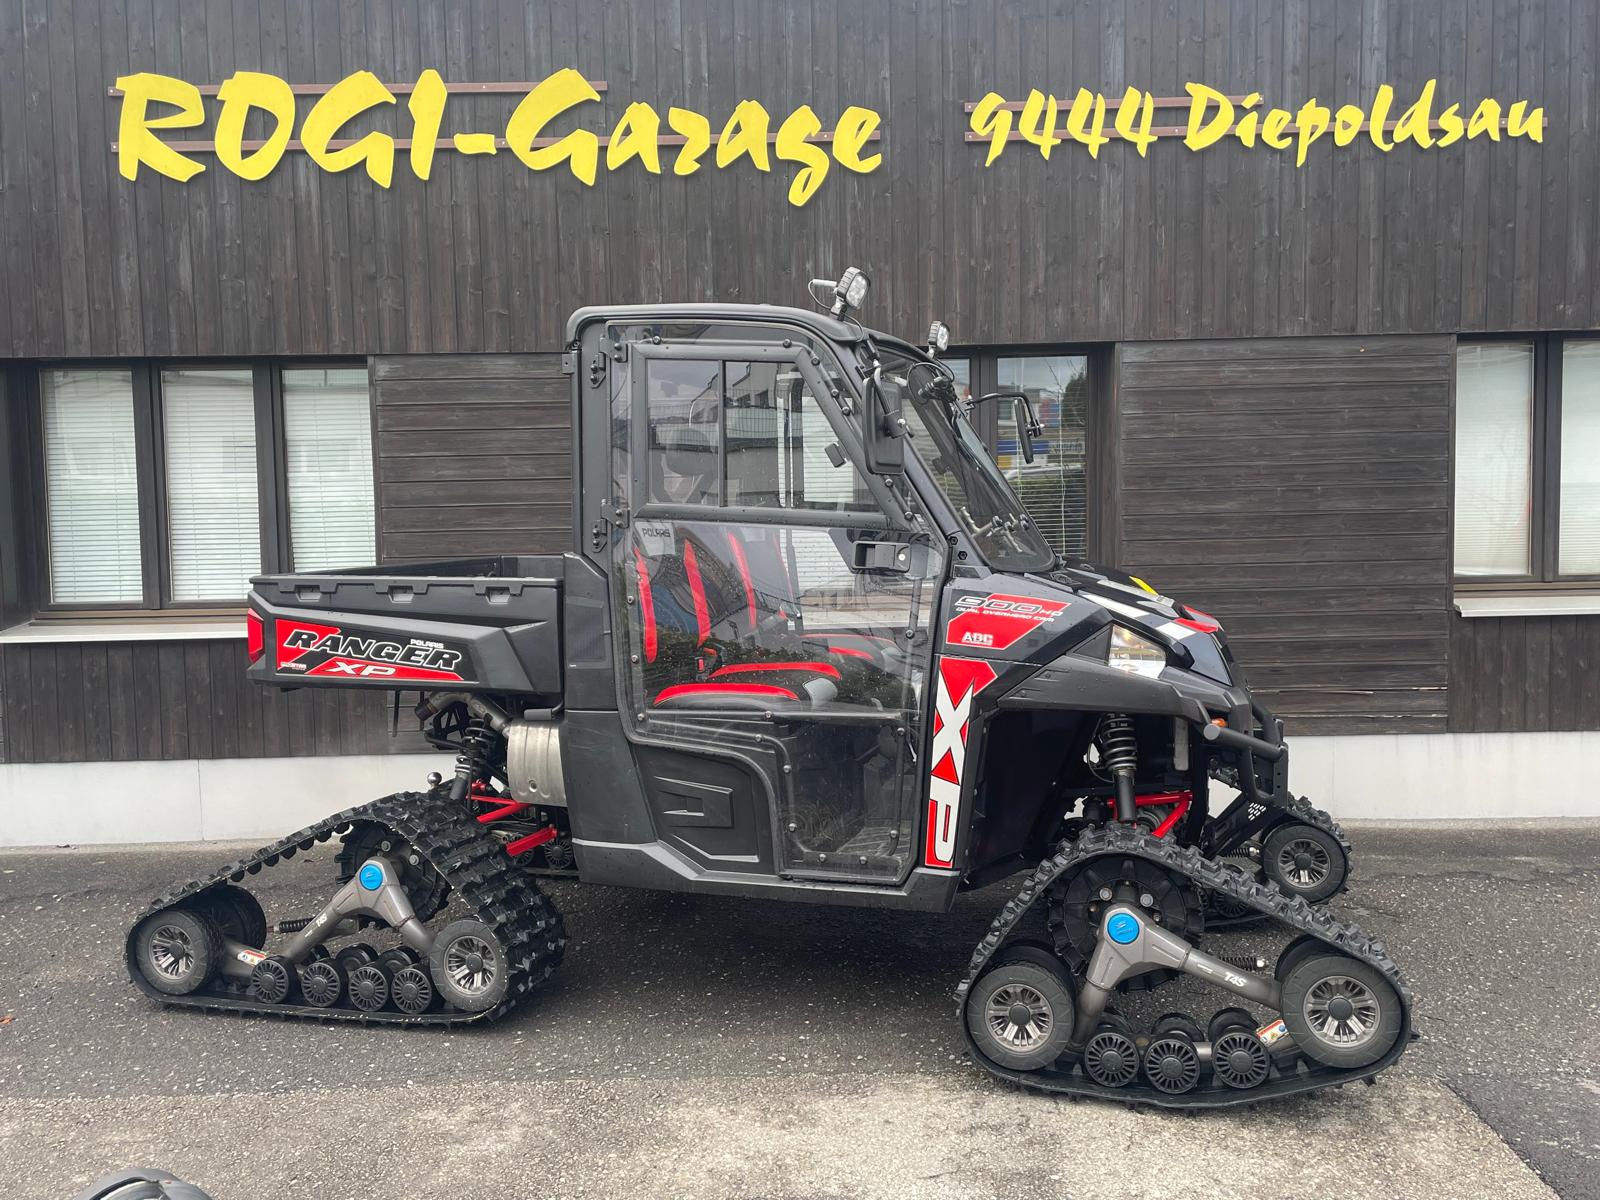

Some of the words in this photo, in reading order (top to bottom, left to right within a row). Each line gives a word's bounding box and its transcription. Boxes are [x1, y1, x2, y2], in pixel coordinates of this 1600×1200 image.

[115, 68, 883, 207] ROGI-Garage
[969, 85, 1158, 167] 9444
[1184, 79, 1544, 168] Diepoldsau
[641, 527, 672, 538] POLARIS
[283, 628, 462, 671] RANGER
[410, 638, 444, 650] POLARIS
[325, 660, 396, 677] XP
[929, 669, 974, 863] XP
